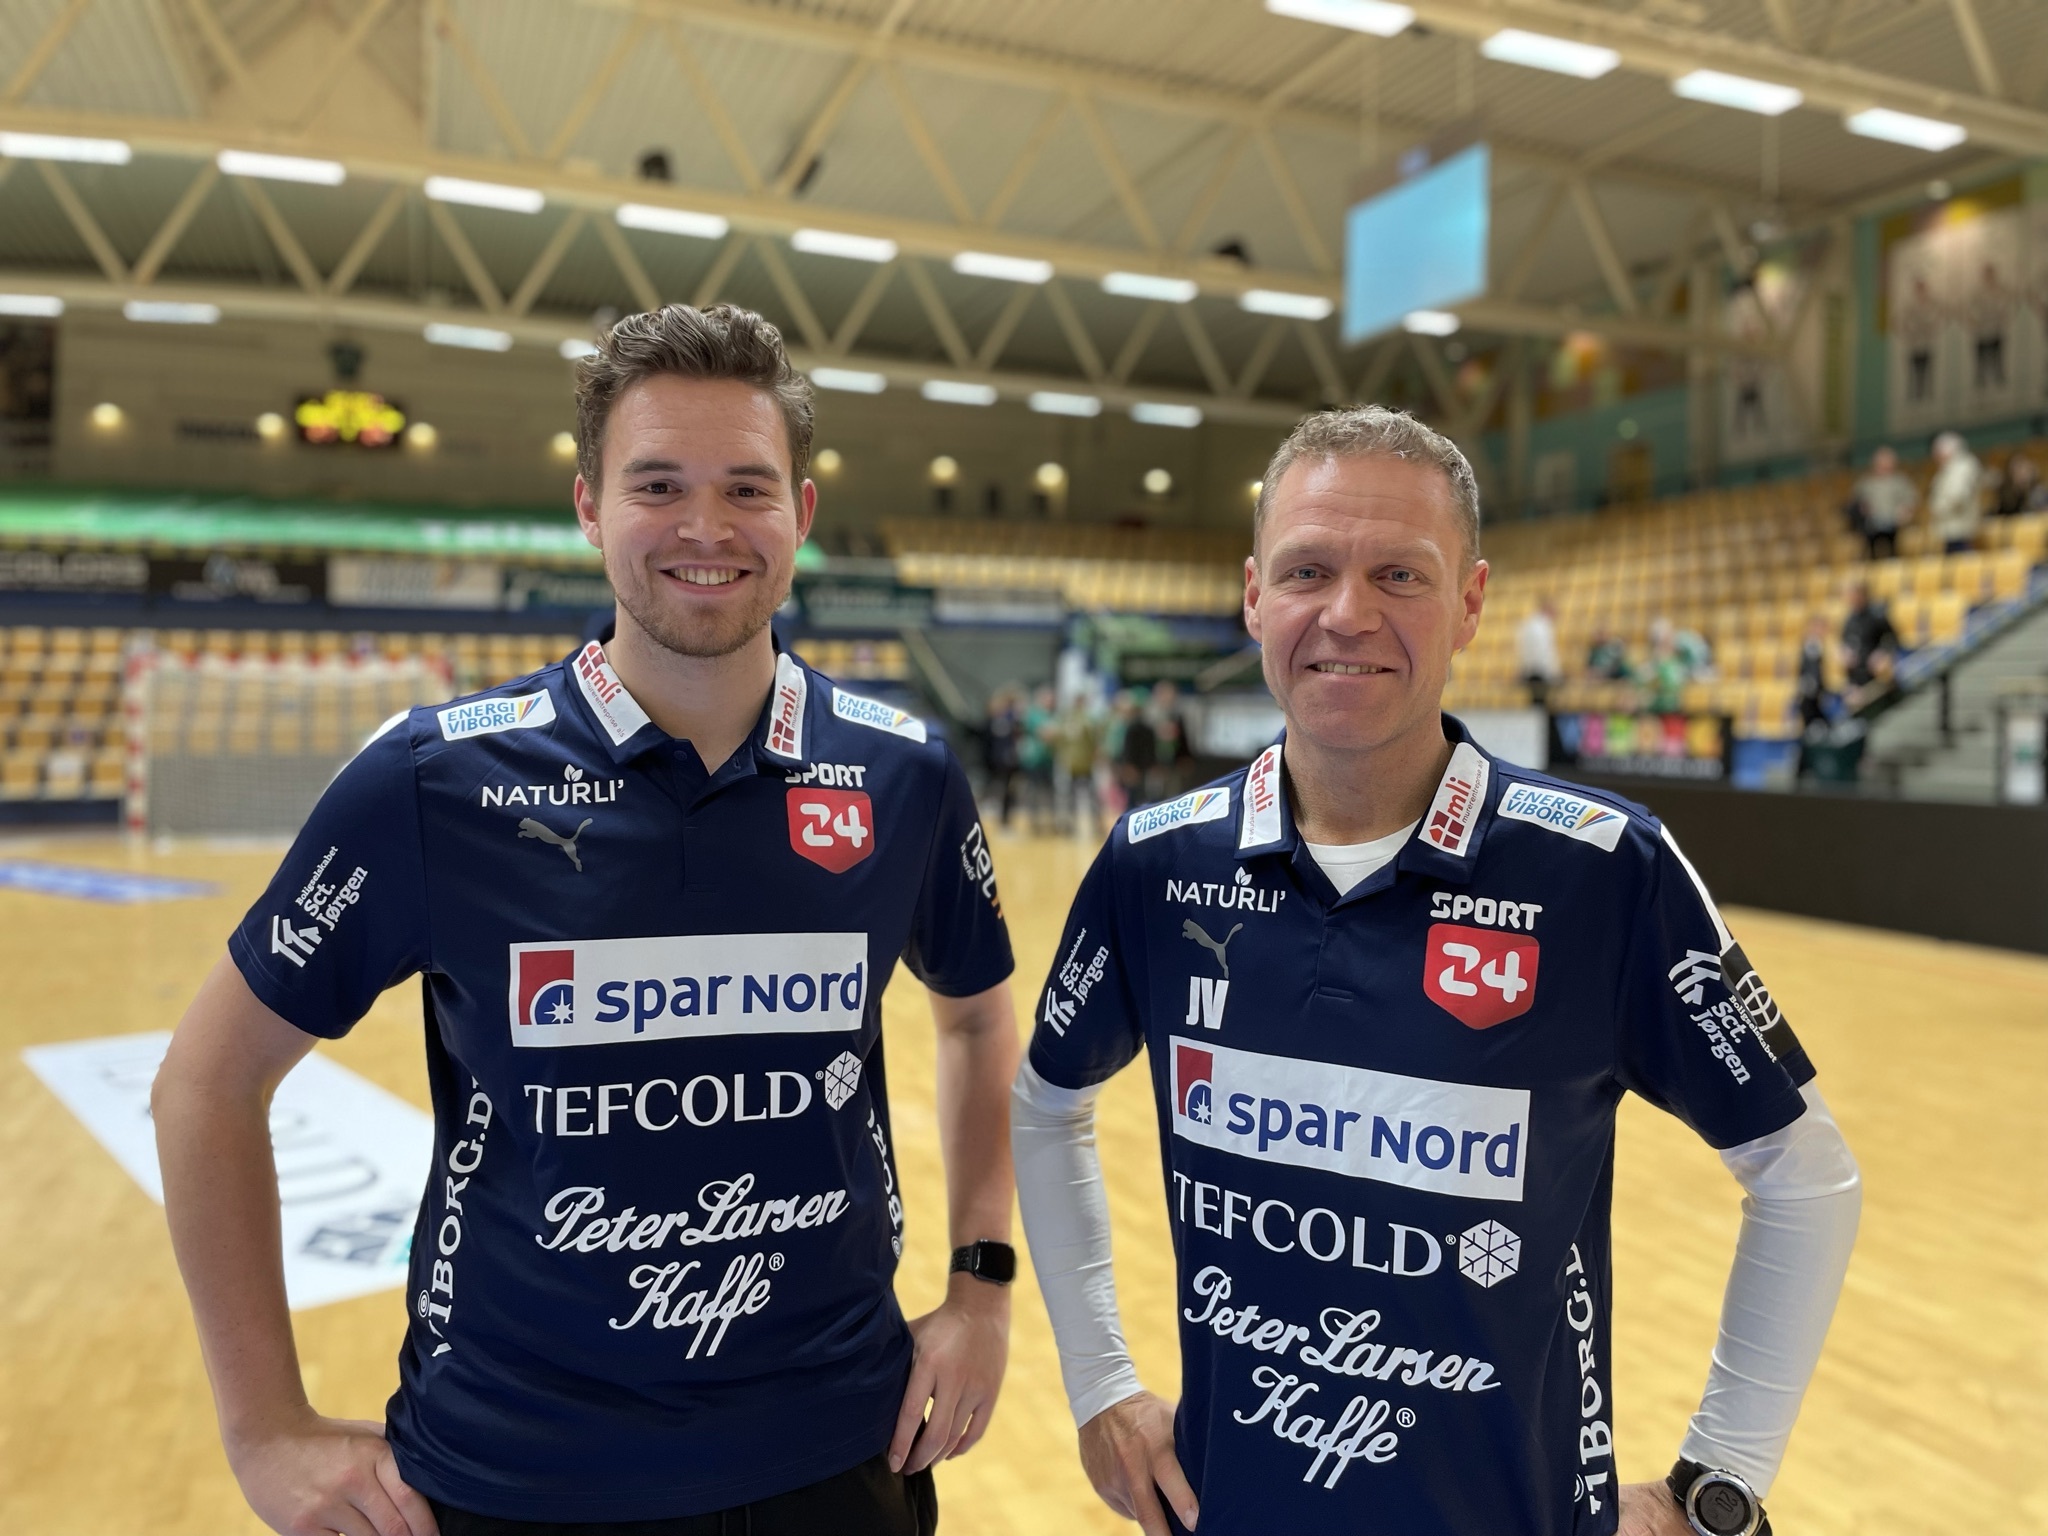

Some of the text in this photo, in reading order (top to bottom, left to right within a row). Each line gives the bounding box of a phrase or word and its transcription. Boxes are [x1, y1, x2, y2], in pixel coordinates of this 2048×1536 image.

[447, 702, 515, 722] ENERGI
[448, 712, 516, 734] VIBORG
[779, 685, 797, 725] mli
[837, 703, 893, 727] VIBORG
[838, 694, 894, 717] ENERGI
[1135, 796, 1195, 824] ENERGI
[1254, 776, 1274, 813] mli
[1445, 776, 1472, 819] mli
[1506, 799, 1579, 829] VIBORG
[1512, 789, 1588, 816] ENERGI
[800, 803, 868, 848] 24
[1133, 807, 1193, 836] VIBORG
[295, 846, 339, 906] Boligselskabet
[303, 883, 336, 917] Sct.
[316, 866, 368, 931] Jørgen
[1429, 891, 1543, 930] SPORT
[1063, 961, 1084, 992] Sct.
[1072, 946, 1109, 1006] Jørgen
[1438, 941, 1528, 1003] 24
[594, 961, 863, 1034] spar Nord
[1185, 976, 1229, 1030] JV
[1711, 1001, 1747, 1044] Sct.
[1728, 995, 1778, 1064] Boligselskabet
[1690, 1009, 1751, 1085] Jørgen
[1226, 1092, 1520, 1178] spar Nord
[535, 1173, 850, 1253] Peter Larsen
[1183, 1265, 1501, 1393] Peter Larsen
